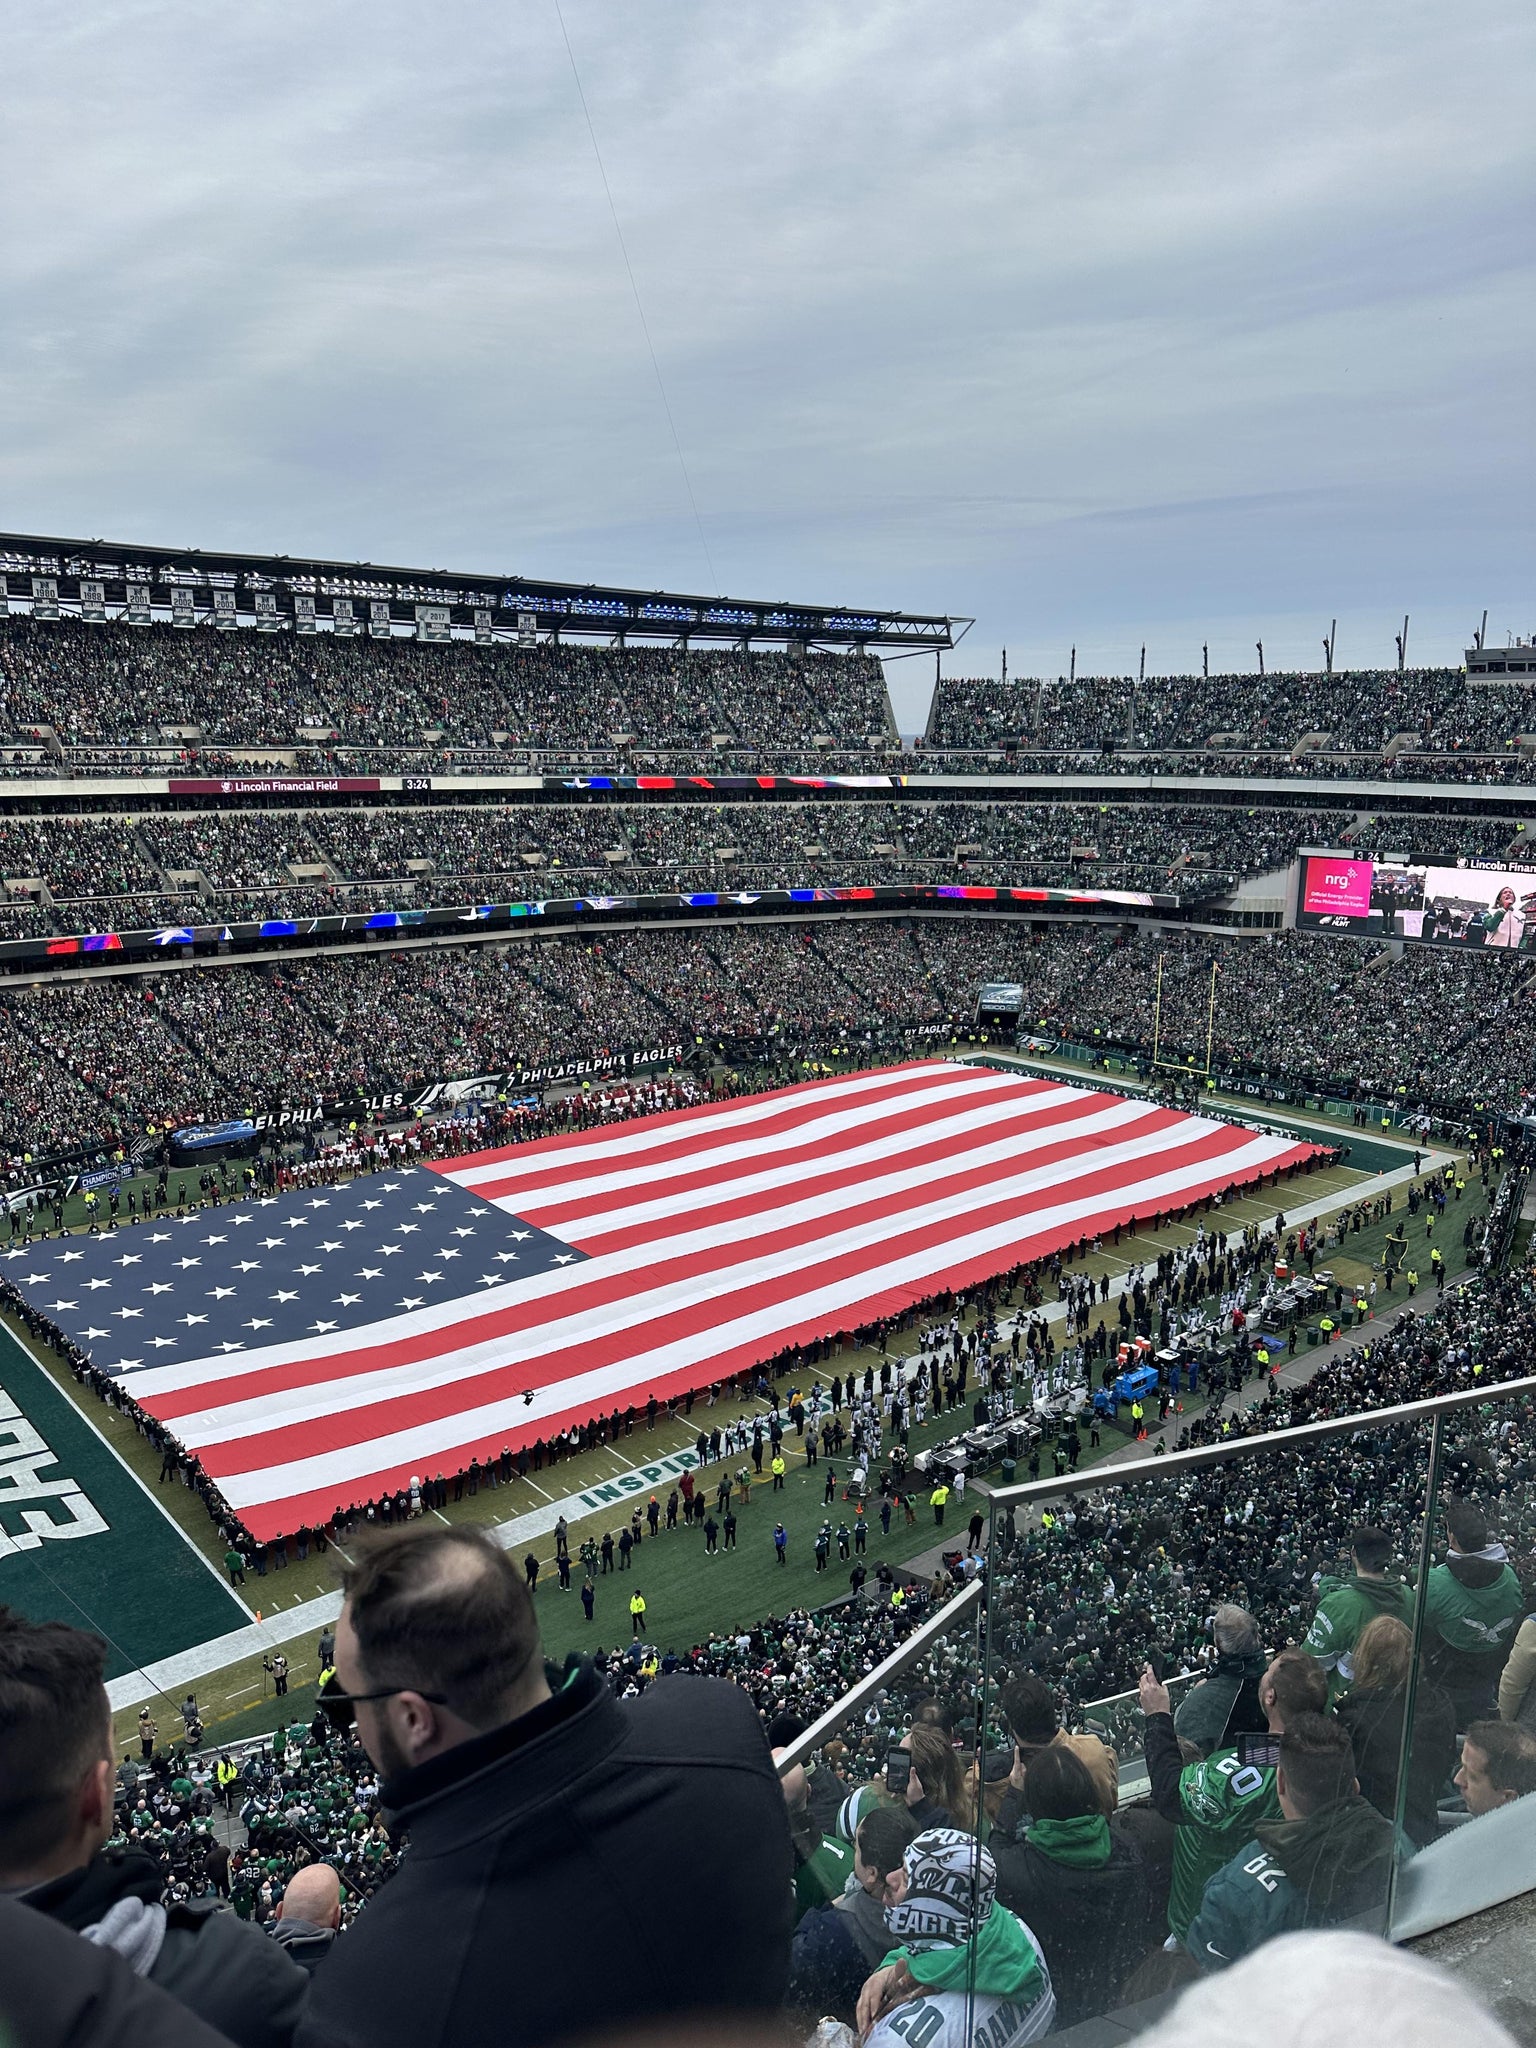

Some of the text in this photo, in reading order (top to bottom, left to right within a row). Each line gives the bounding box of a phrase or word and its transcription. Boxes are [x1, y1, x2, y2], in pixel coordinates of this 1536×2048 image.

[130, 595, 148, 604] 2001
[174, 598, 192, 607] 2002
[216, 600, 234, 609] 2003
[257, 602, 274, 612] 2004
[373, 612, 388, 620] 2013
[520, 622, 535, 630] 2022
[235, 780, 338, 792] Lincoln Financial Field
[406, 780, 428, 790] 3:24
[1470, 860, 1506, 871] Lincoln
[1325, 874, 1348, 890] nrg
[632, 1046, 682, 1064] EAGLES
[82, 1166, 132, 1187] CHAMPIONHIP
[264, 1766, 276, 1776] 20
[822, 1840, 844, 1860] 1
[887, 1905, 974, 1941] EAGLE
[888, 1996, 945, 2048] 20
